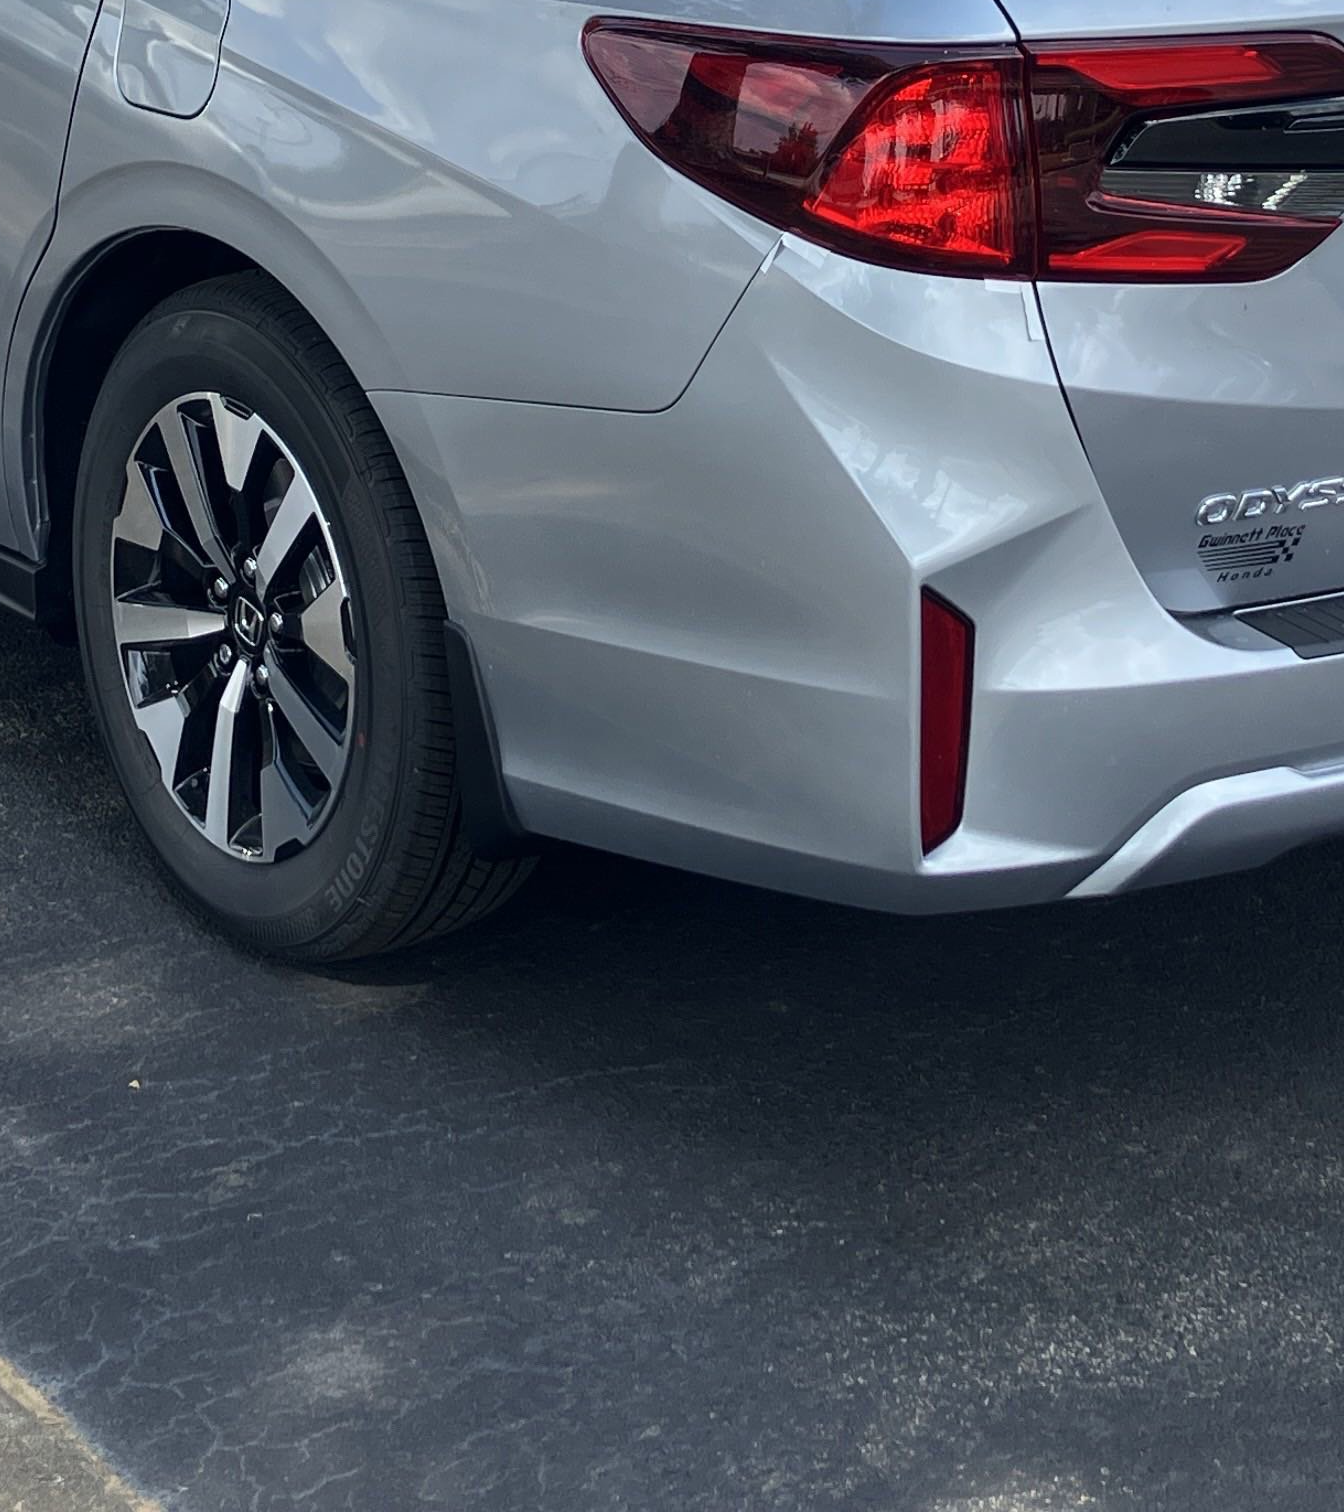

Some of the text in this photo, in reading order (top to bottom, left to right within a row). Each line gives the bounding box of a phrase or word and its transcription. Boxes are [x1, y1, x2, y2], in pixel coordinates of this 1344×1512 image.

[1198, 525, 1305, 548] Gwinnett Place
[1217, 567, 1273, 582] Honda
